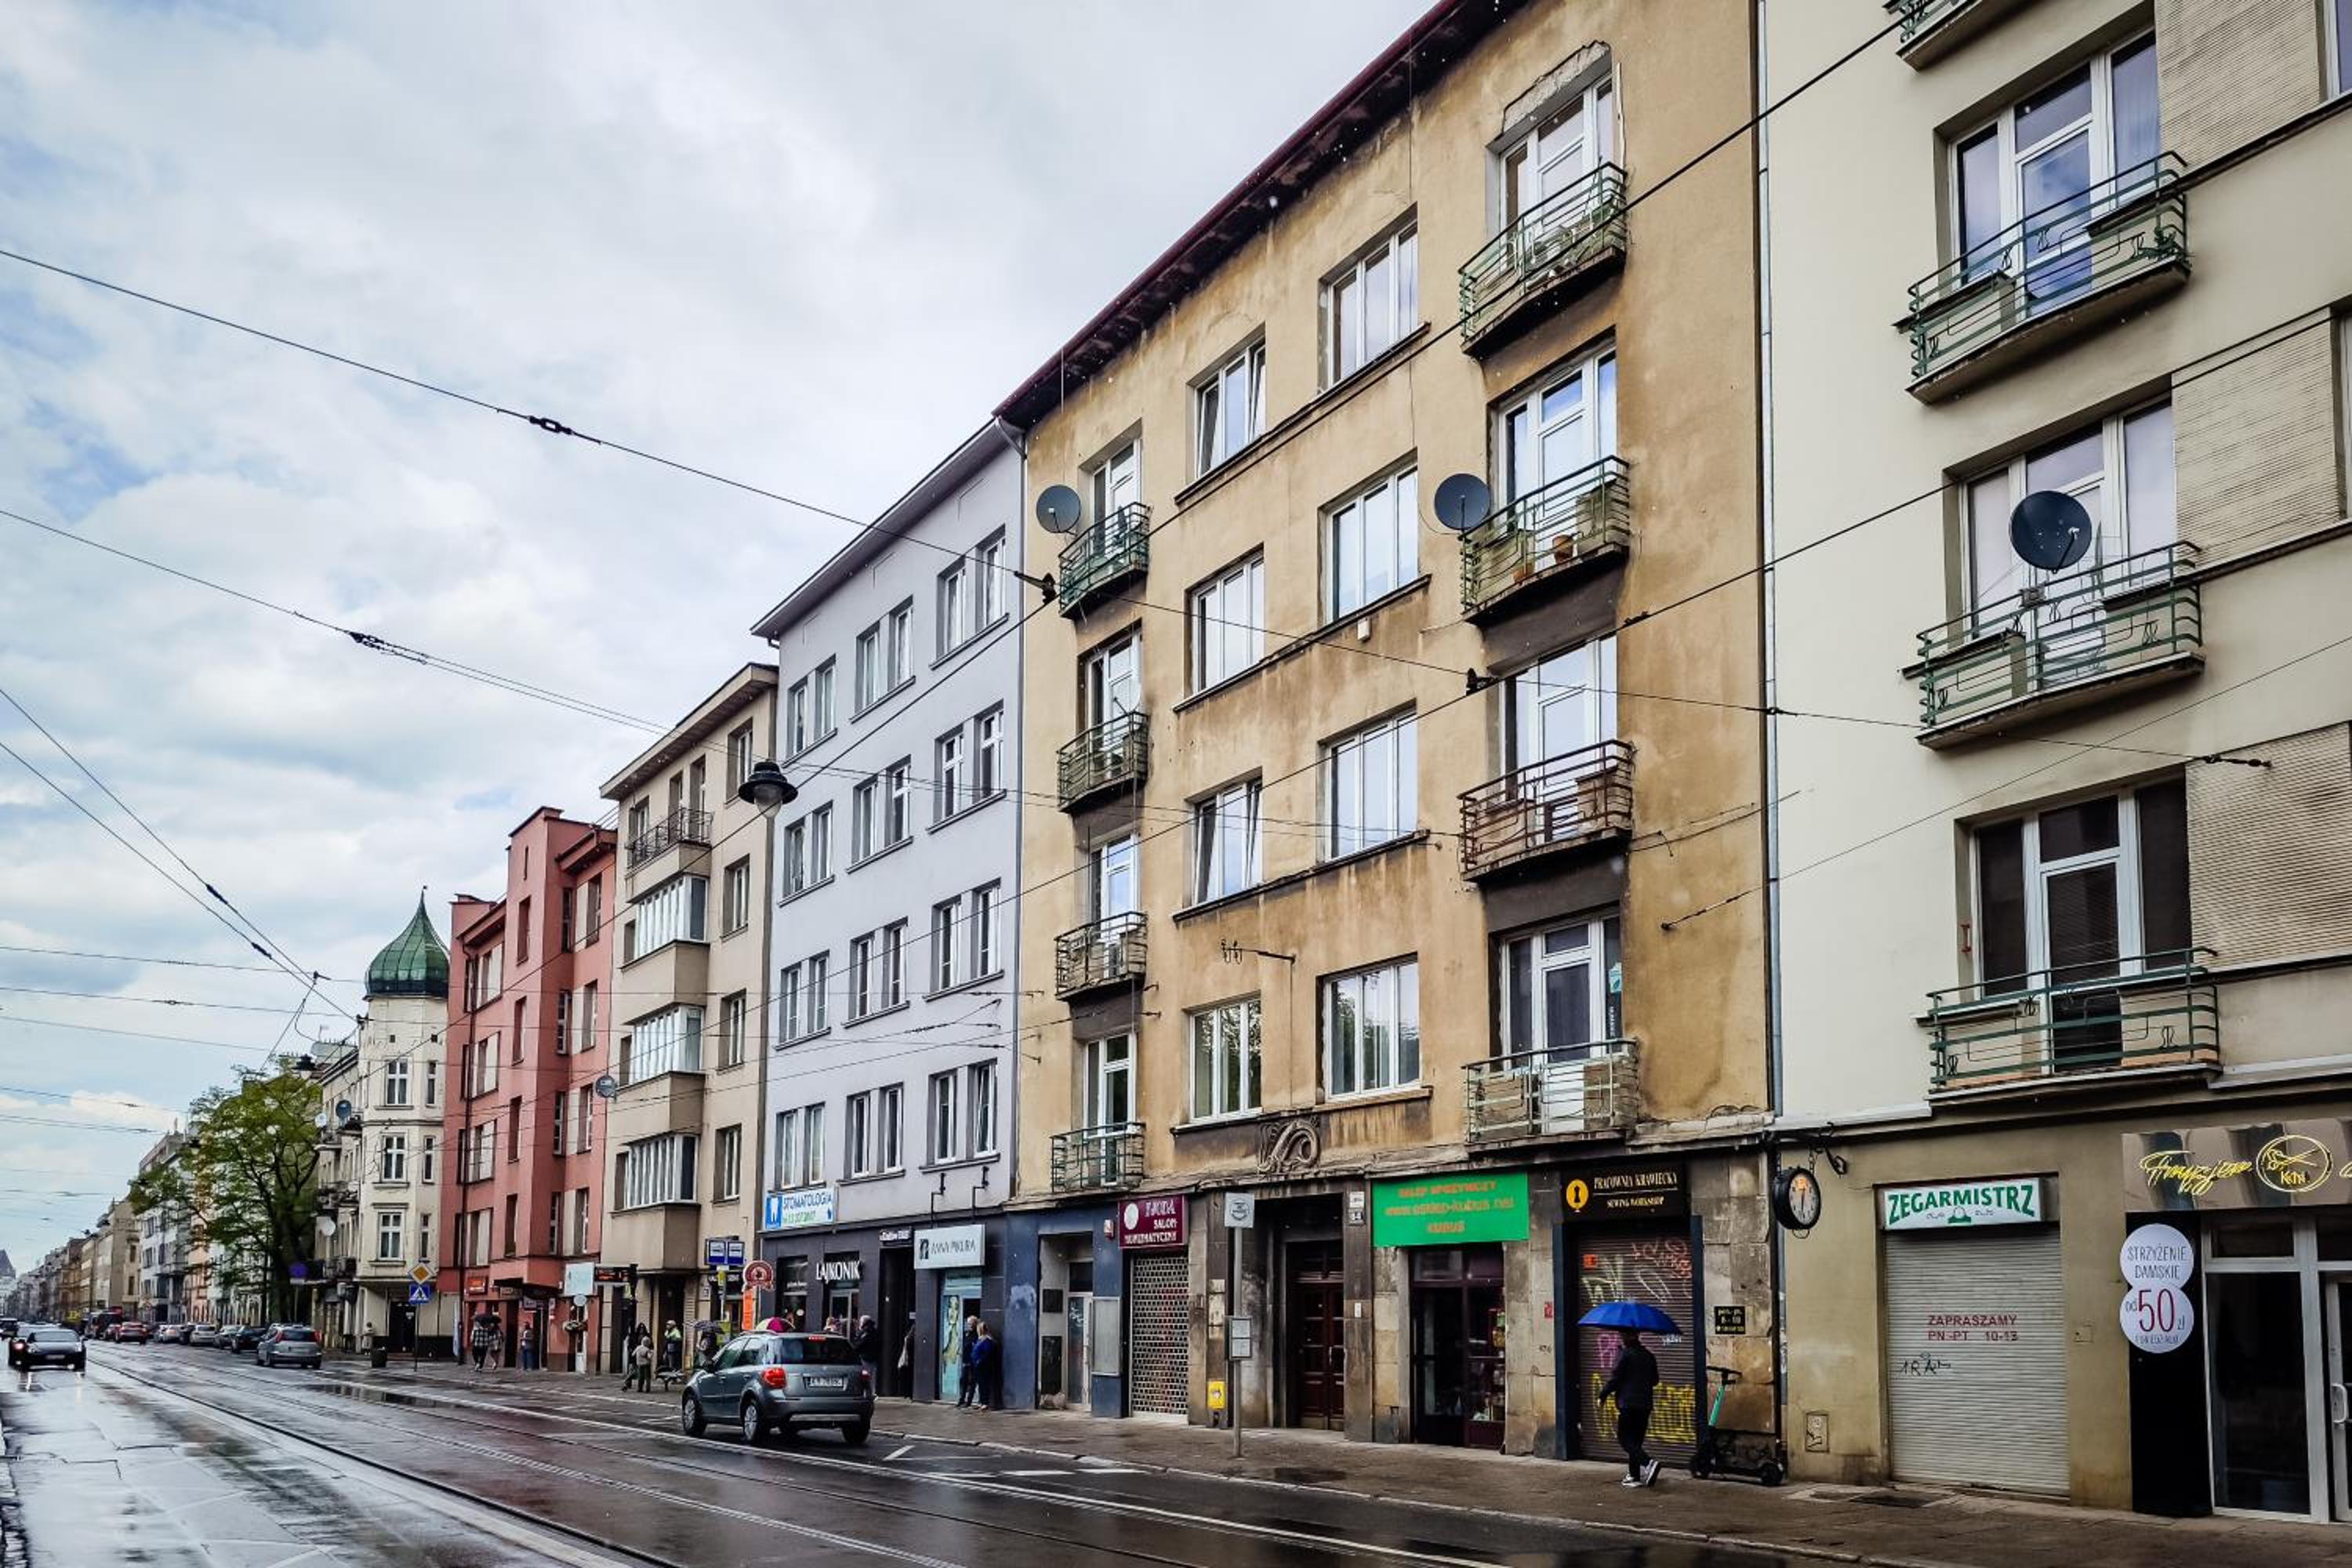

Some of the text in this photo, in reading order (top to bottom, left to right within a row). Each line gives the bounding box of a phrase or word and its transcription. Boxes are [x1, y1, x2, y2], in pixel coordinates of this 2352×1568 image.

[1593, 1171, 1678, 1190] PRACOWNIA KRAWIECKA
[1887, 1185, 2034, 1225] ZEGARMISTRZ
[1153, 1218, 1178, 1230] SALON
[2127, 1243, 2187, 1261] STRZYŻENIE
[816, 1261, 861, 1284] LAJKONIK
[2135, 1265, 2180, 1280] DAMSKIE
[2139, 1288, 2175, 1332] 50
[1928, 1315, 2018, 1326] ZAPRASZAMY
